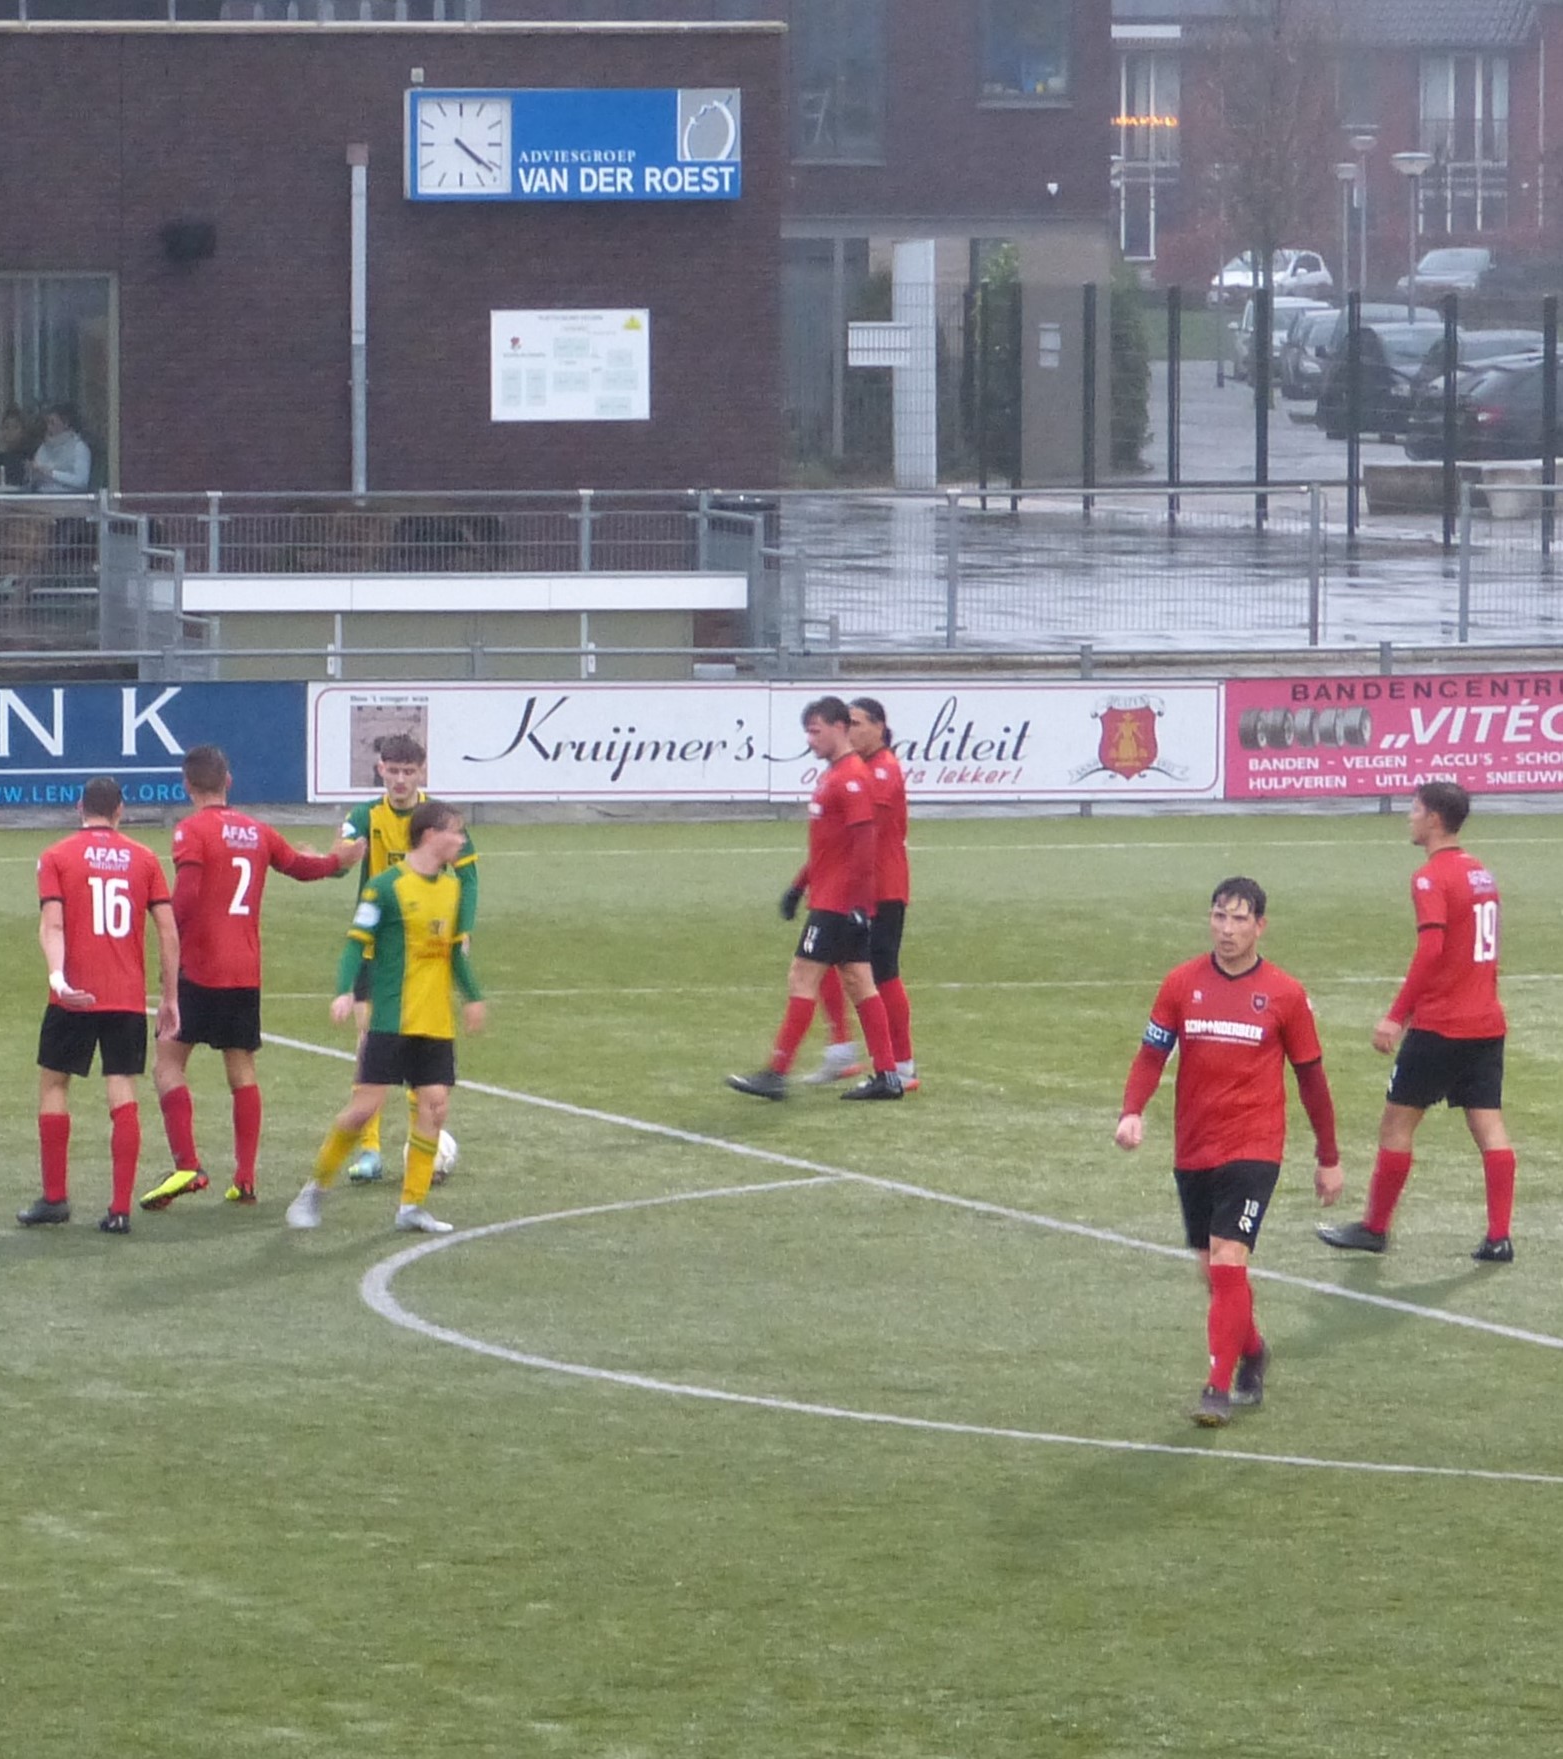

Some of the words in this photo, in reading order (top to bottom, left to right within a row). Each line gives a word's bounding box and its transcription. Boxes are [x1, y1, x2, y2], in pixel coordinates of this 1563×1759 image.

[518, 150, 637, 164] ADVIESGROEP
[518, 166, 569, 194] VAN
[579, 166, 634, 193] DER
[644, 166, 735, 193] ROEST
[1291, 677, 1563, 701] BANDENCENTR
[462, 696, 755, 783] Kruijmer's
[1248, 756, 1320, 772] BANDEN
[1342, 754, 1407, 769] VELGEN
[1430, 752, 1494, 767] ACCU'S
[1515, 751, 1563, 766] SCHO
[936, 766, 1022, 784] lekker!
[1248, 774, 1348, 791] HULPVEREN
[1375, 772, 1458, 788] UITLATEN
[222, 824, 258, 841] AFAS
[84, 846, 131, 863] AFAS
[228, 856, 252, 916] 2
[87, 876, 132, 938] 16
[1472, 900, 1498, 962] 19
[1244, 1198, 1259, 1218] 18
